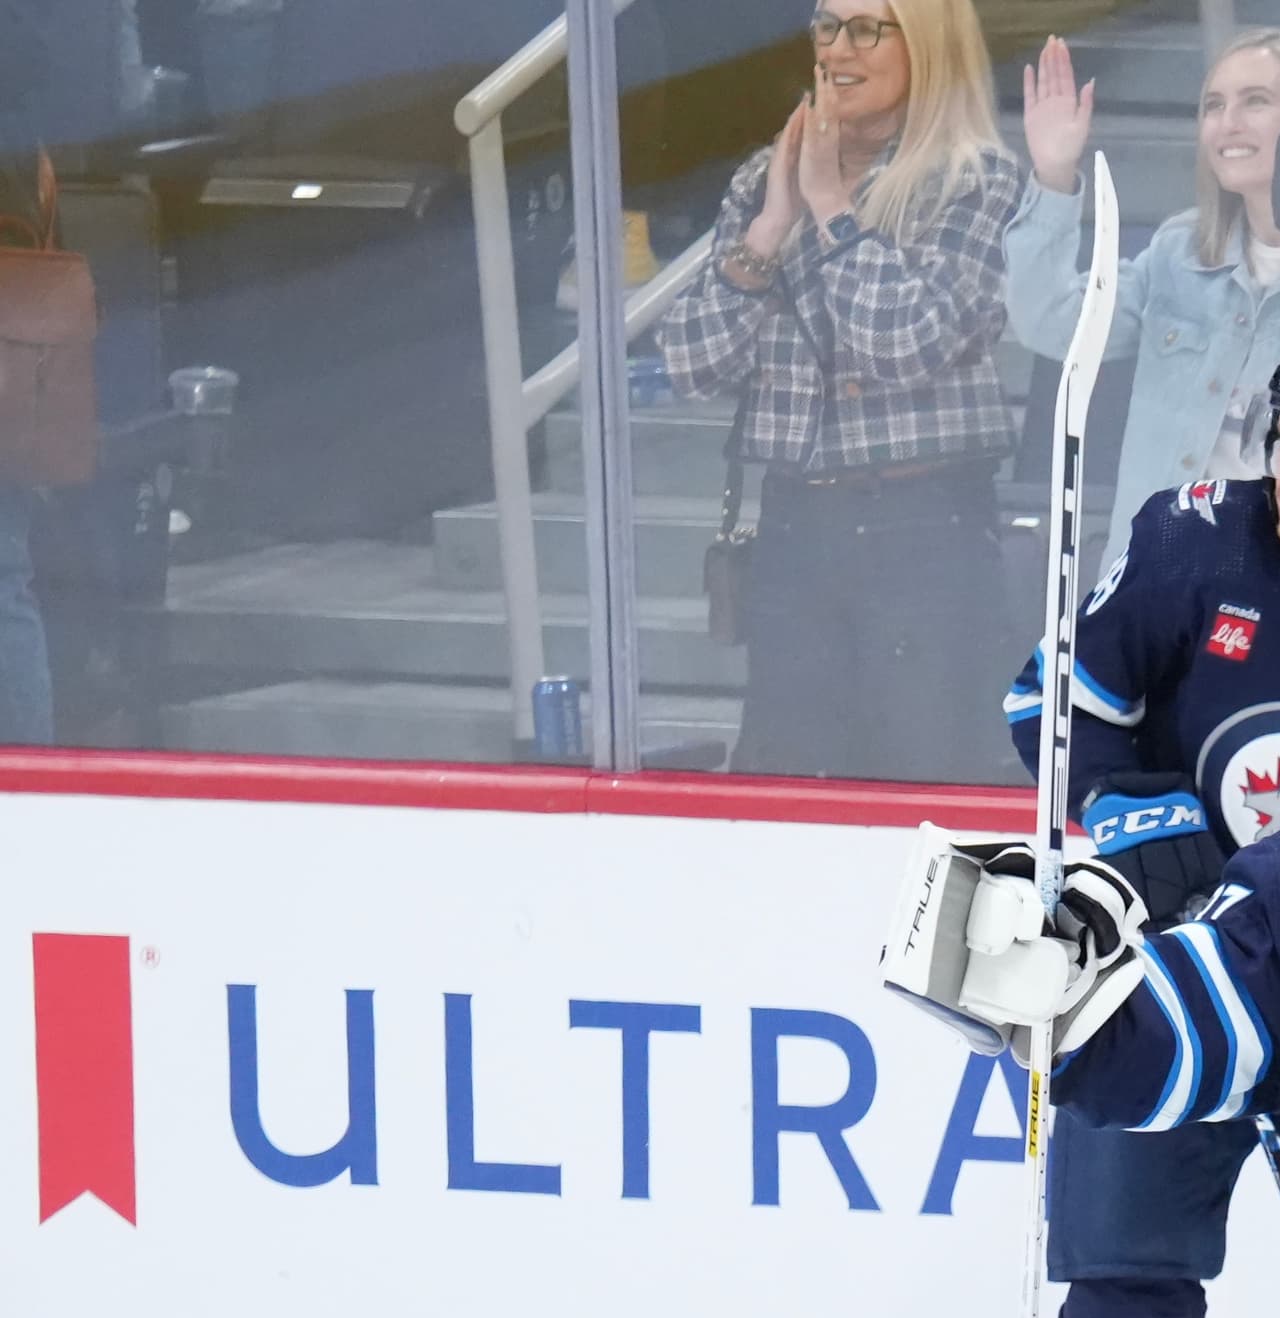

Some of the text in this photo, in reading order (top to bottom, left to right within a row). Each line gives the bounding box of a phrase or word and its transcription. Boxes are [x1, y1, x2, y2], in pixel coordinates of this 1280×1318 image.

[1218, 603, 1261, 622] canada
[1209, 623, 1252, 655] life
[1092, 803, 1203, 846] CCM
[904, 853, 948, 958] TRUE
[226, 983, 1052, 1216] ULTRA
